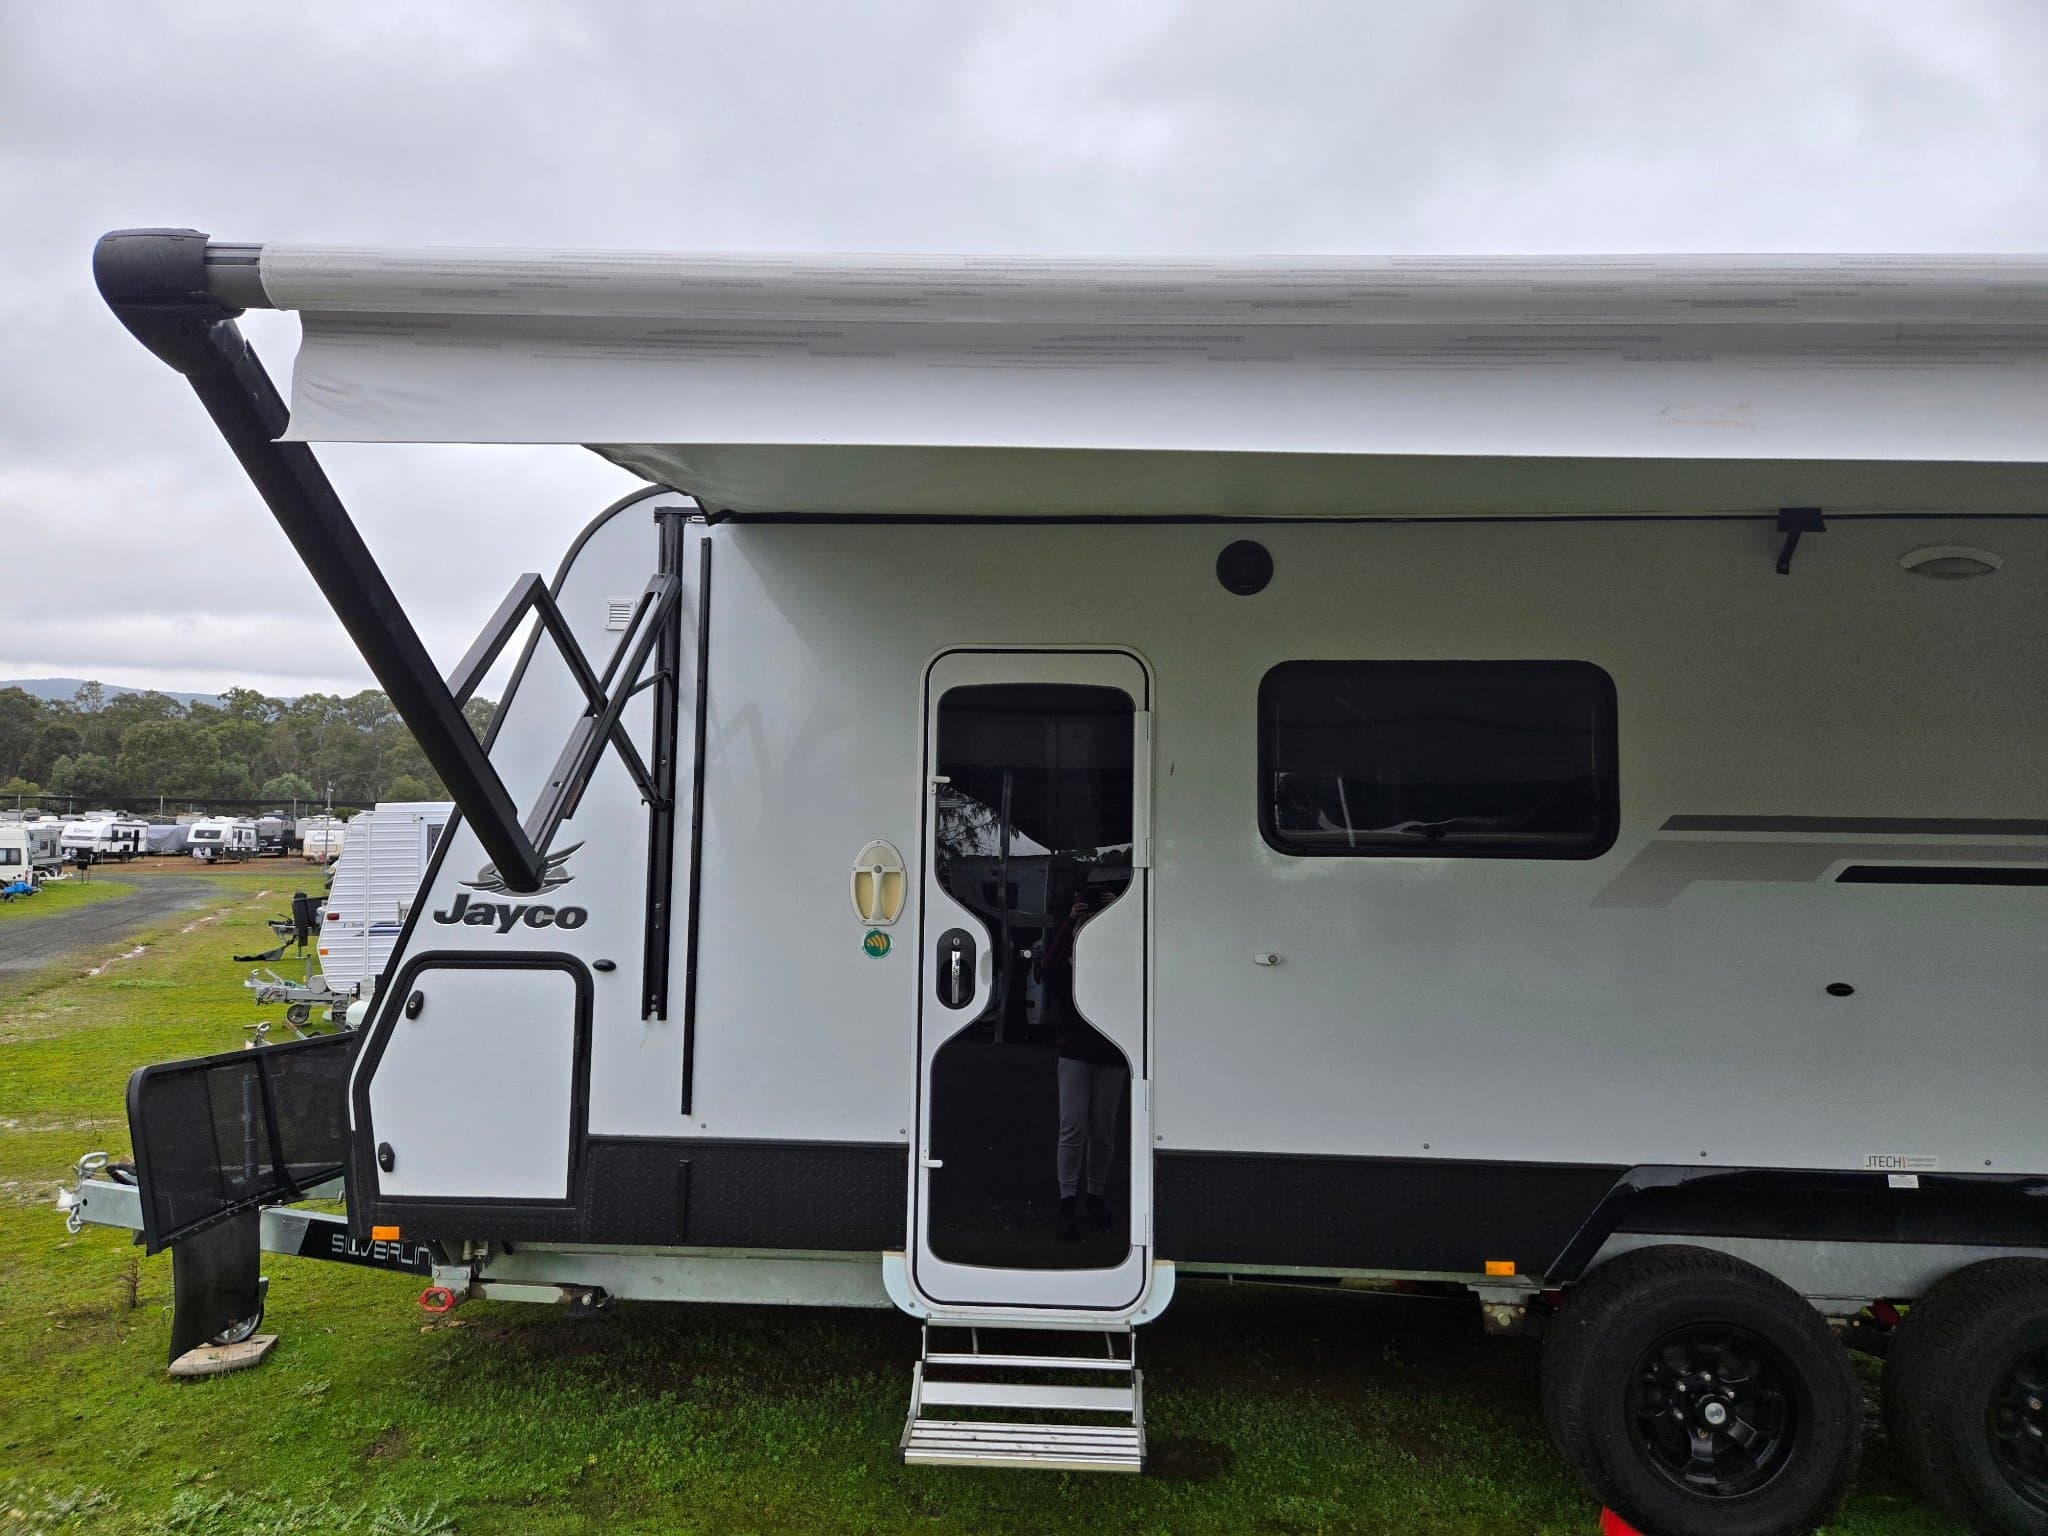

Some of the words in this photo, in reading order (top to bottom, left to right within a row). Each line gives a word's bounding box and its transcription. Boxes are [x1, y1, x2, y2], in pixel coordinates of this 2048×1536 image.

[433, 893, 589, 935] Jayco
[1865, 1155, 1901, 1168] JTECH
[331, 1233, 432, 1267] SILVERLIN
